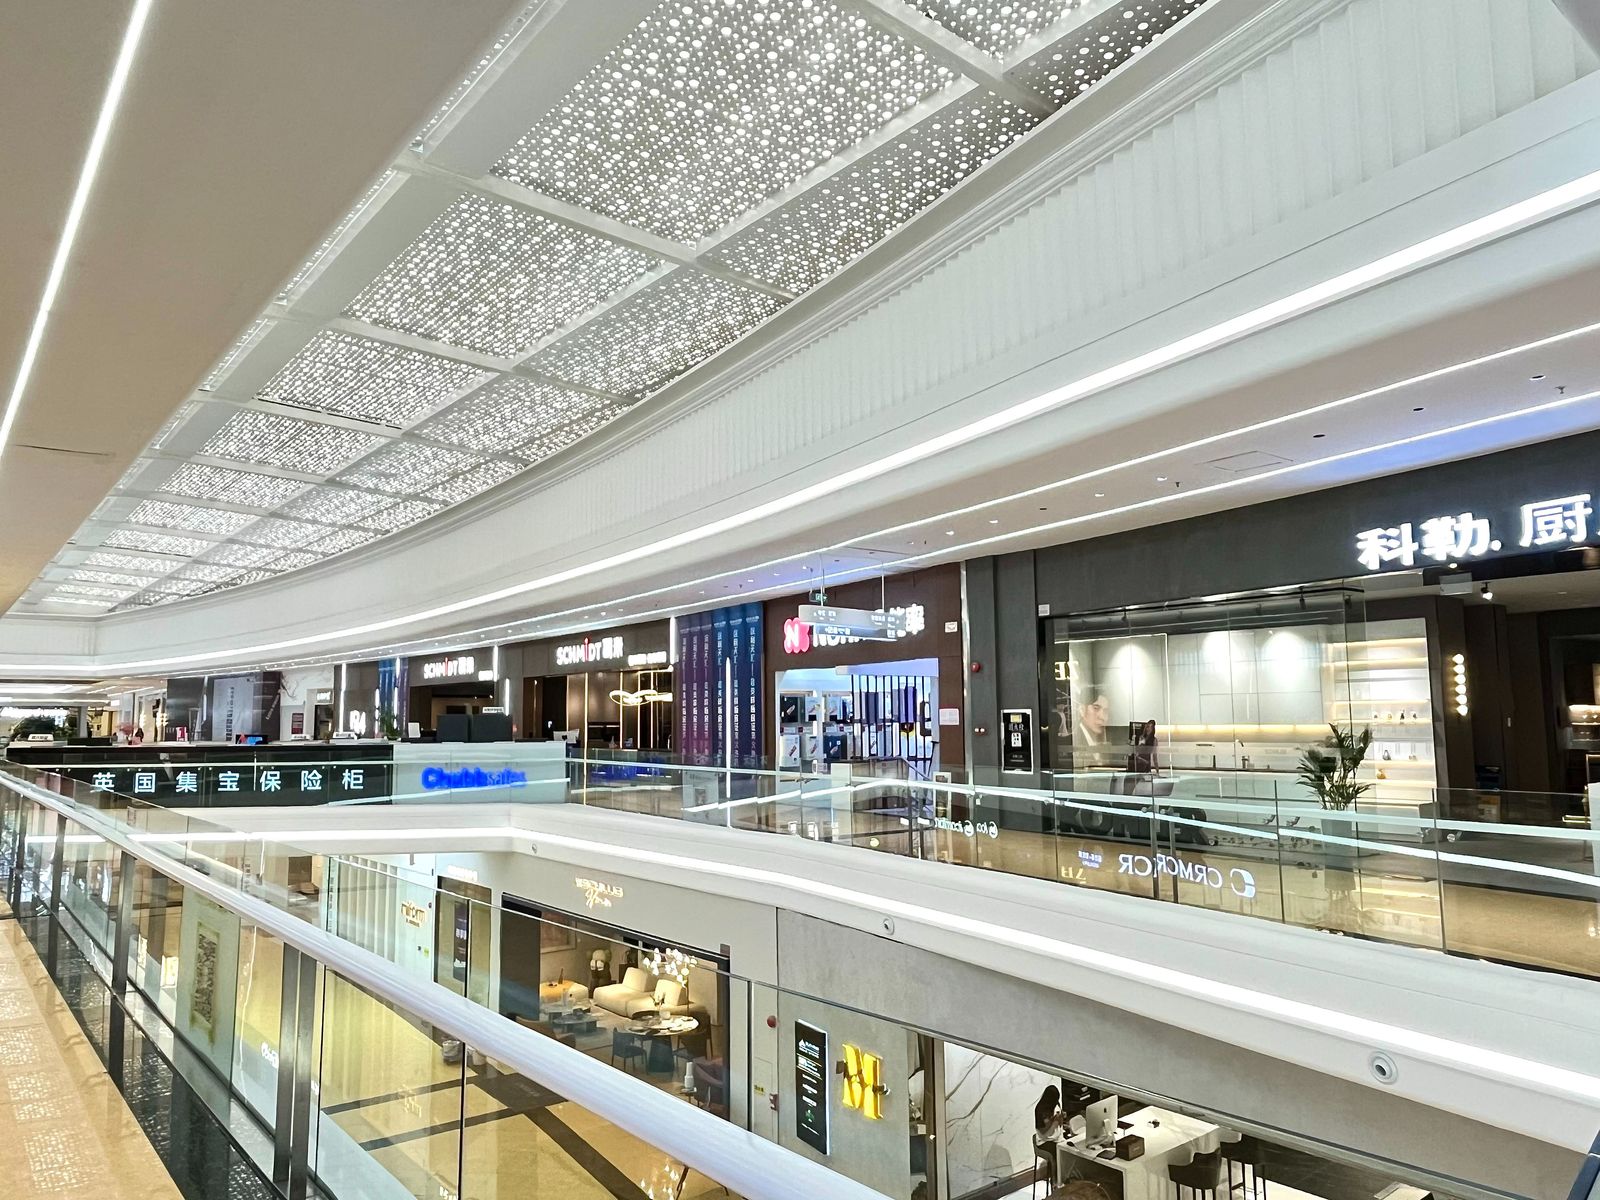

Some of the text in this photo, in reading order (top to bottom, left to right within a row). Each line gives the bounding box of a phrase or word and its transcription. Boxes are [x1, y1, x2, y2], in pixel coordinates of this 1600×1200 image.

[1356, 494, 1600, 570] 科勒.厨
[90, 769, 364, 794] 英国集宝保险柜
